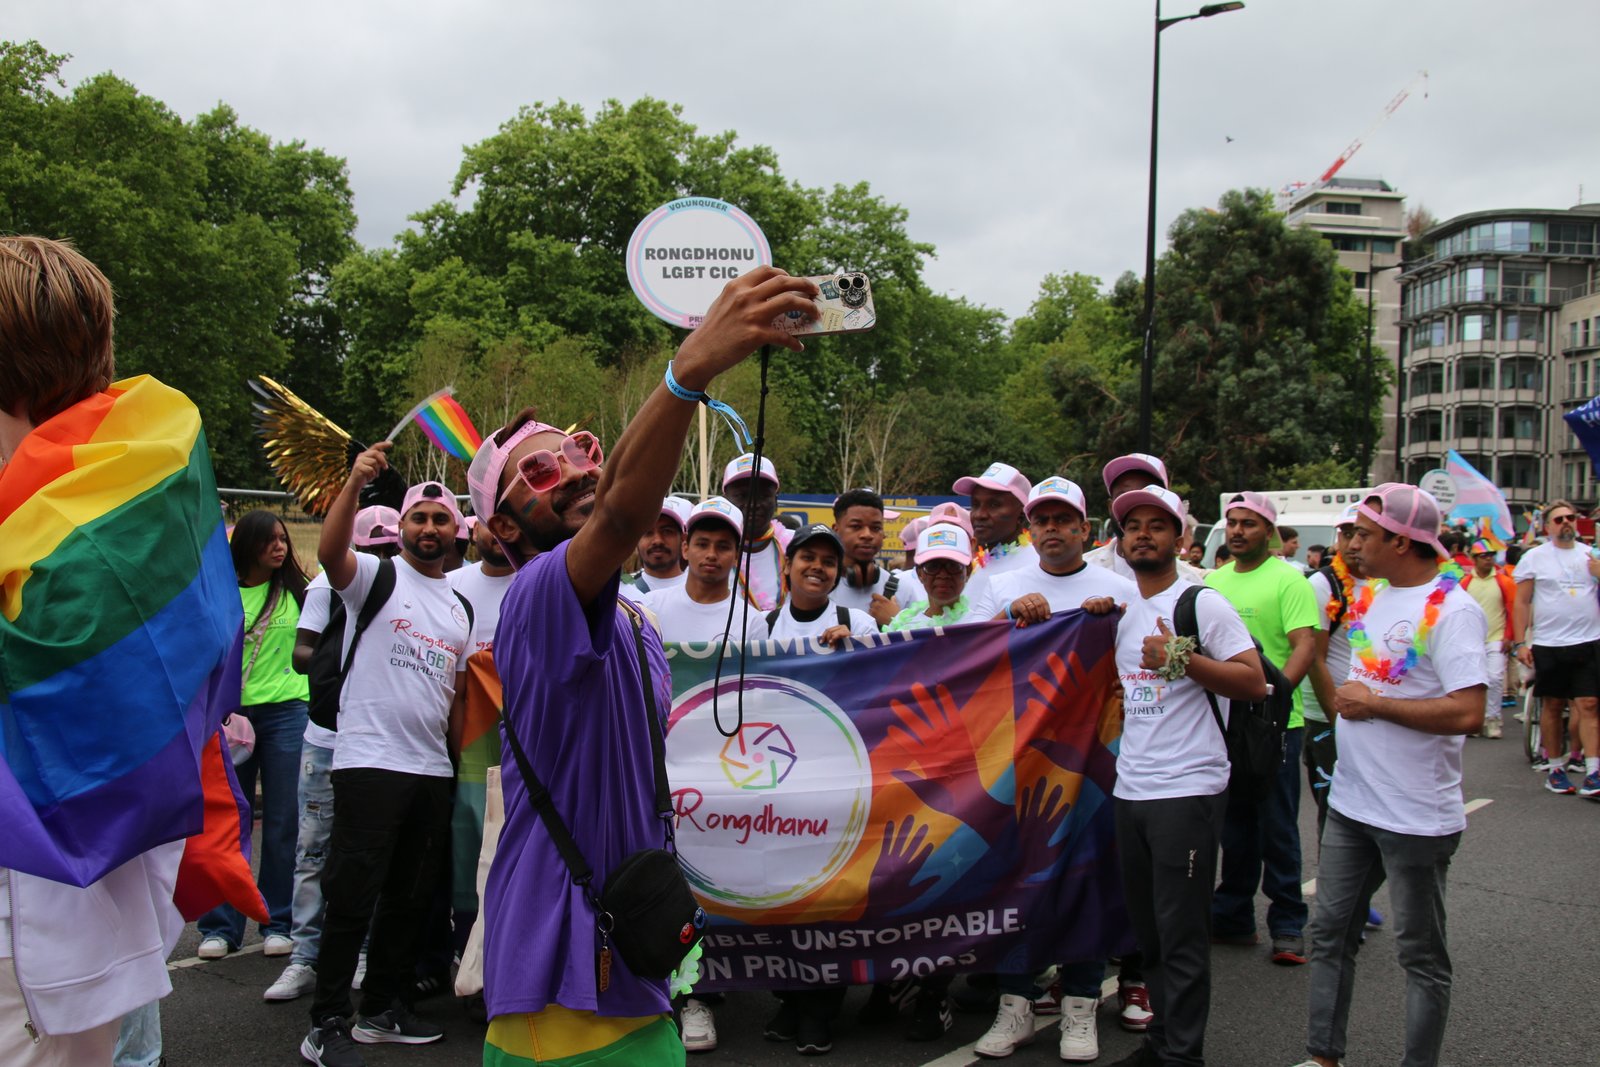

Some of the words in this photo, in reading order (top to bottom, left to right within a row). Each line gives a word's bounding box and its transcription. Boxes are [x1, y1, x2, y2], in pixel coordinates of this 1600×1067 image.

[669, 199, 729, 213] VOLUNQUEER
[644, 247, 755, 261] RONGDHONU
[662, 265, 706, 280] LGBT
[712, 265, 739, 280] CIC
[391, 643, 416, 659] ASIAN
[416, 645, 456, 674] LGBT
[671, 787, 829, 845] Rongdhanu
[699, 932, 783, 948] IBLE.
[790, 908, 1026, 951] UNSTOPPABLE.
[743, 955, 840, 984] PRIDE
